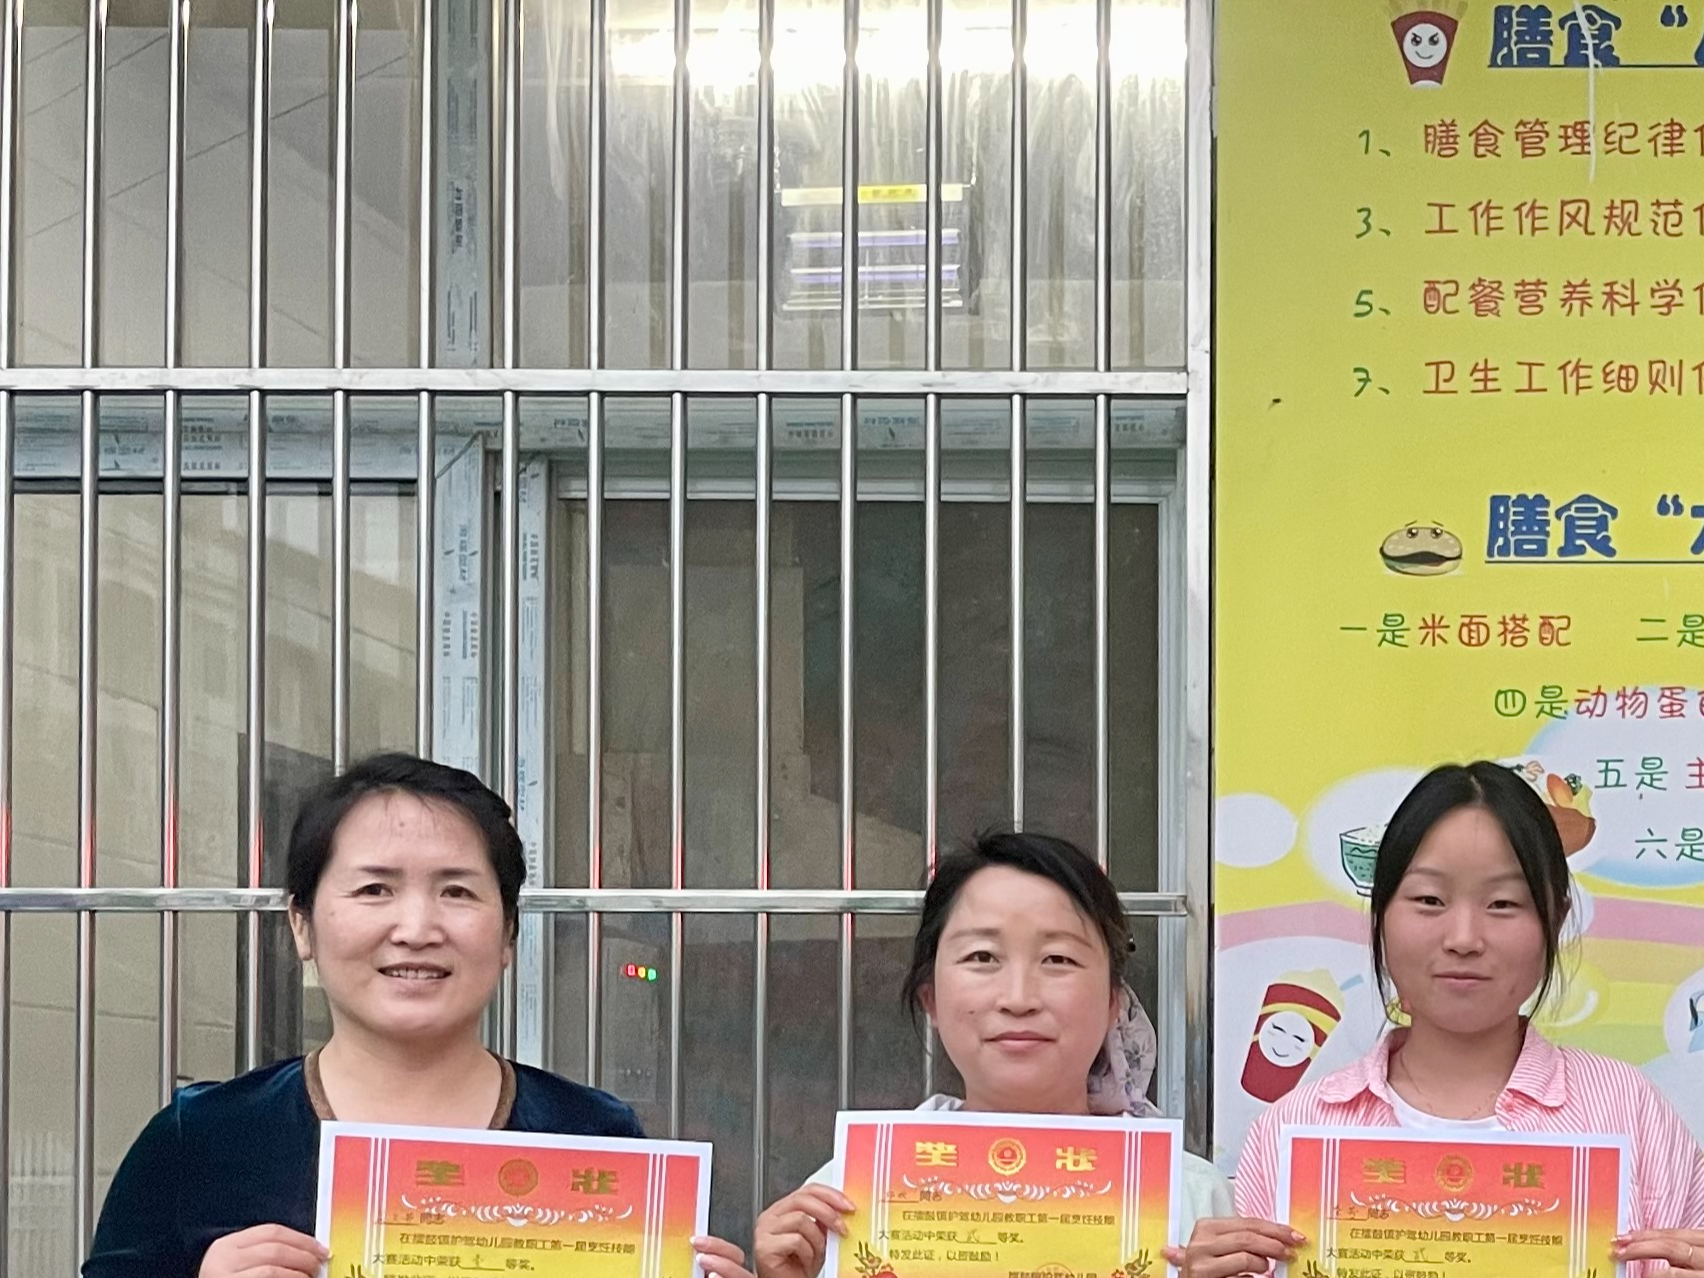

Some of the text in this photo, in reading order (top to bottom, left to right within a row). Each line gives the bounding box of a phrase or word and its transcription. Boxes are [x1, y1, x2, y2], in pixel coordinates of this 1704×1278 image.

[1339, 614, 1572, 648] 一是米面搭配
